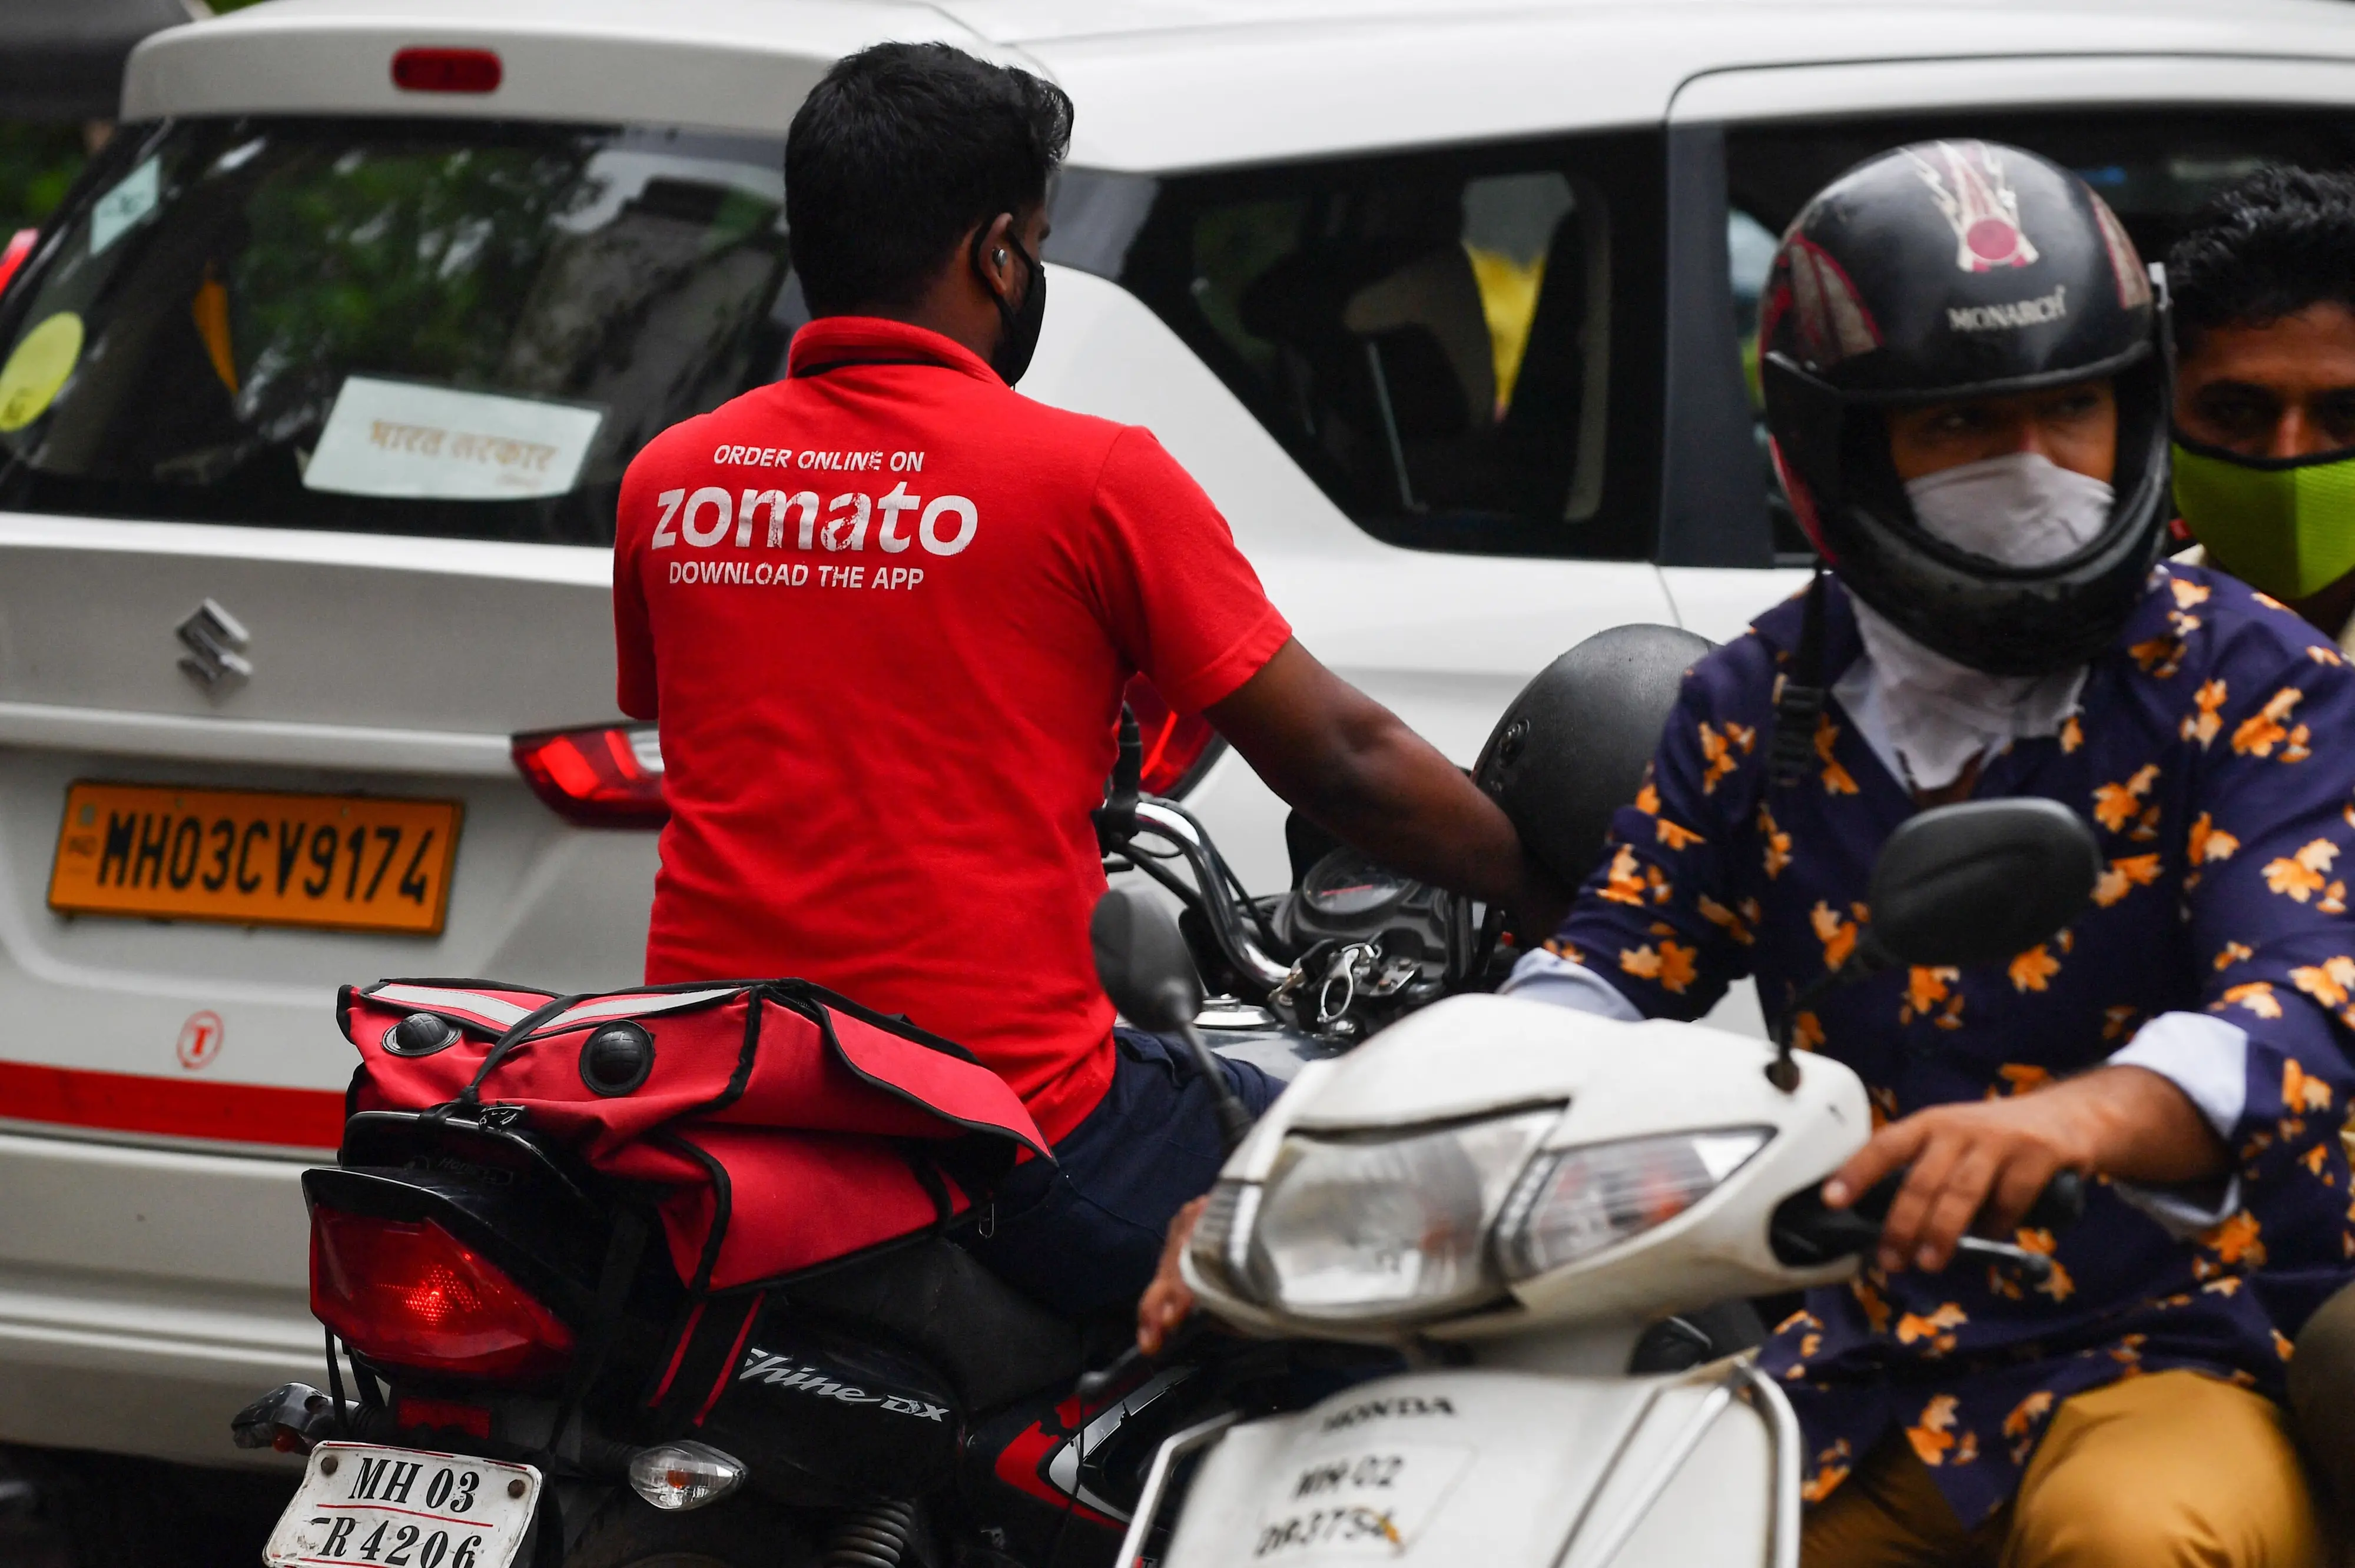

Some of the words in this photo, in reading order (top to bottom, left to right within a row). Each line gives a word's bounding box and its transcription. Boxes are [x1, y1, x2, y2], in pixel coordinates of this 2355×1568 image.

[370, 419, 450, 456] भारत
[714, 444, 791, 469] ORDER
[797, 450, 884, 471] ONLINE
[890, 451, 924, 472] ON
[652, 481, 978, 556] zomato
[669, 561, 809, 586] DOWNLOAD
[818, 565, 864, 588] THE
[871, 567, 924, 590] APP
[97, 810, 436, 905] MH03CV9174
[880, 1394, 950, 1422] DX
[1322, 1396, 1457, 1432] HONDA
[348, 1457, 423, 1503] MH
[426, 1468, 480, 1513] 03
[360, 1520, 482, 1568] 4206
